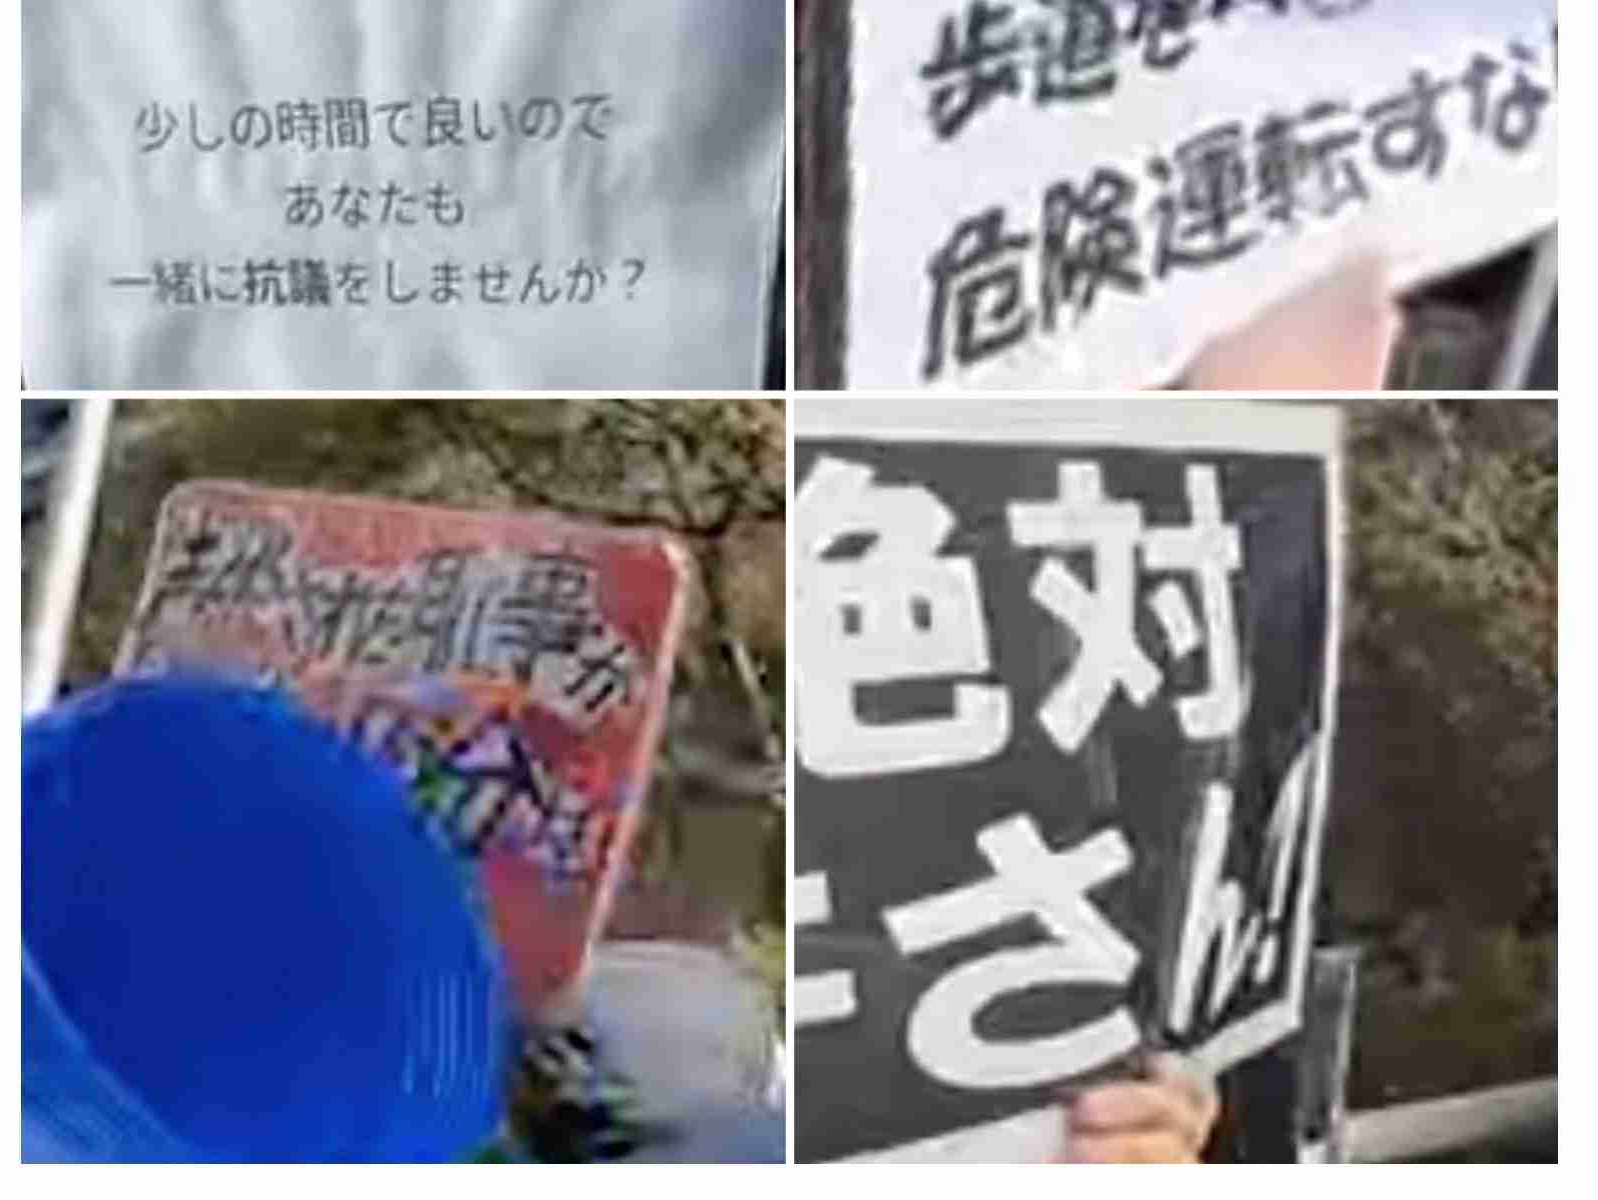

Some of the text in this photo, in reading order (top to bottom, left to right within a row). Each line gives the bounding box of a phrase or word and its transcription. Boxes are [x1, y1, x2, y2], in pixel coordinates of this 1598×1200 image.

[283, 185, 465, 229] あなたも
[922, 40, 1552, 381] 危険運転すな
